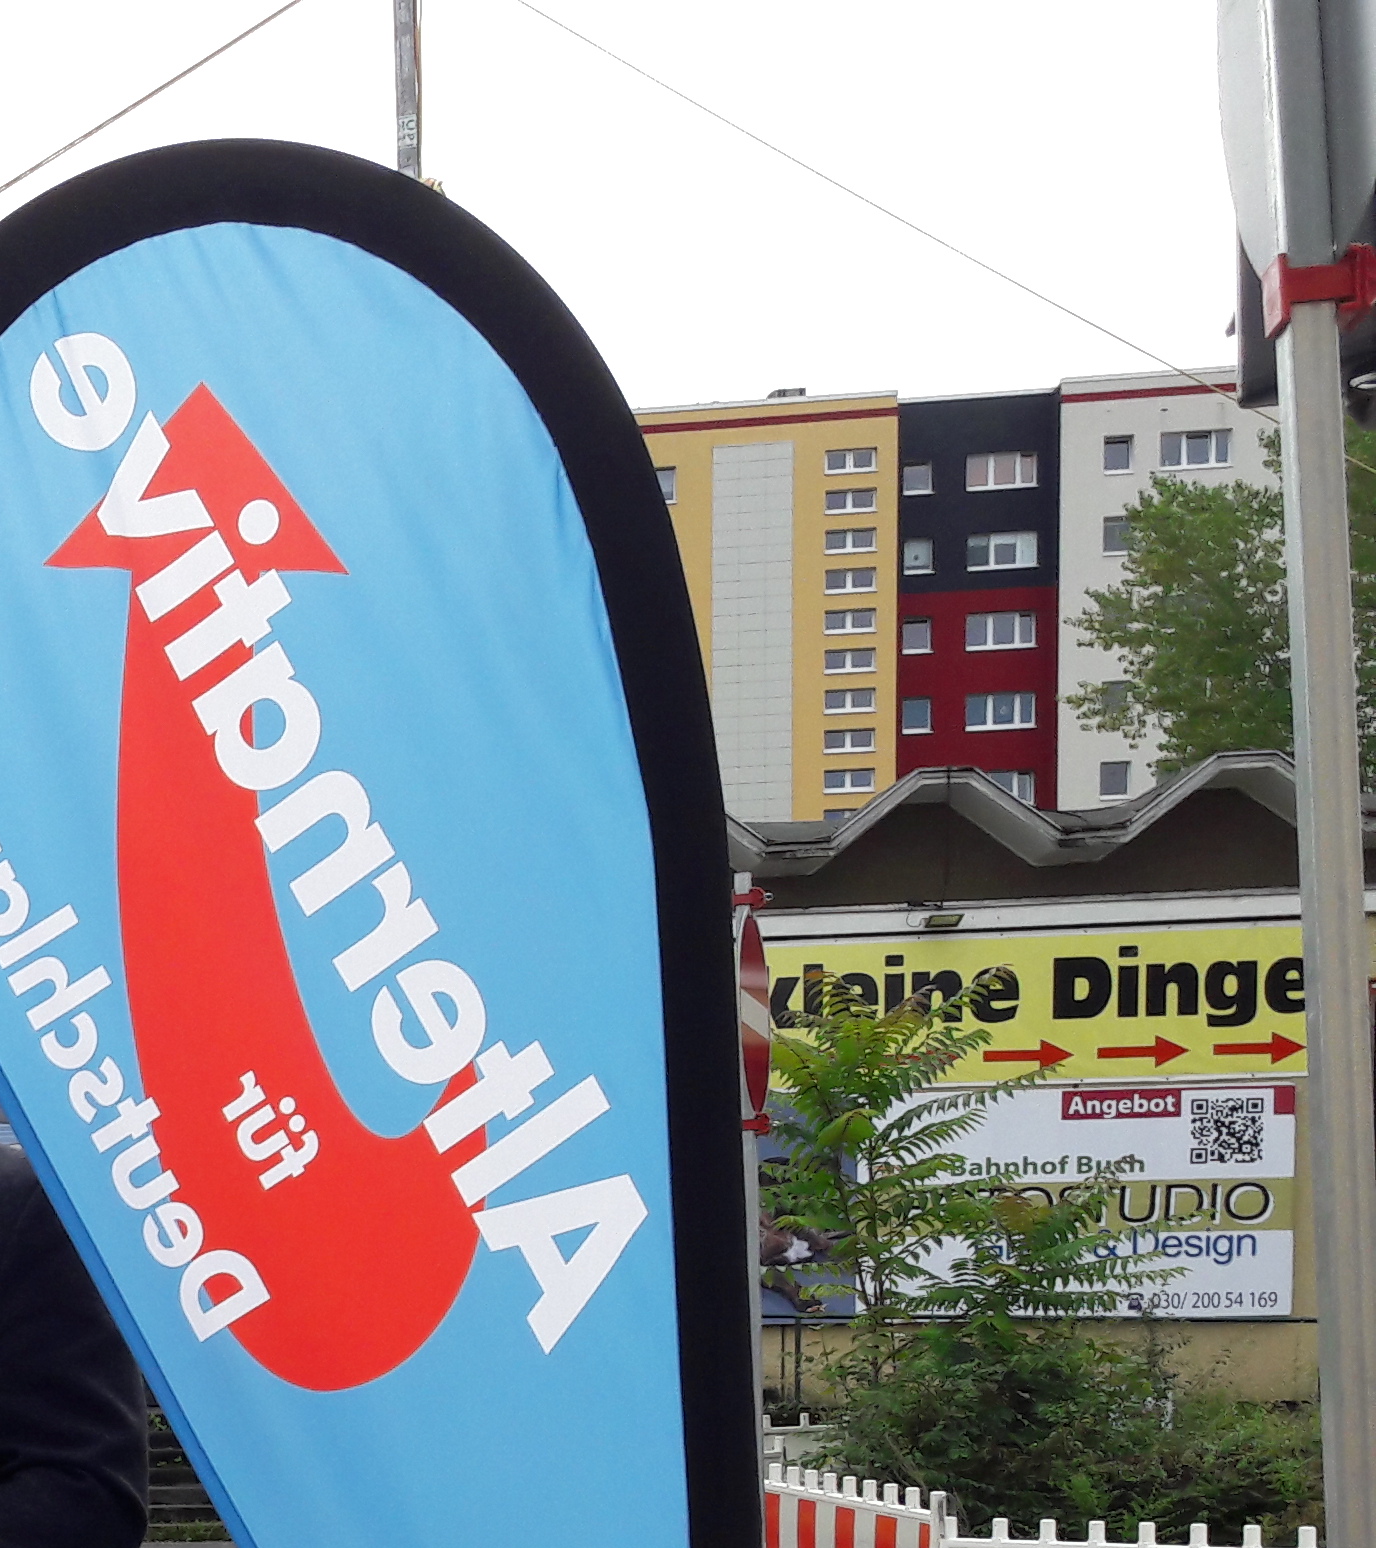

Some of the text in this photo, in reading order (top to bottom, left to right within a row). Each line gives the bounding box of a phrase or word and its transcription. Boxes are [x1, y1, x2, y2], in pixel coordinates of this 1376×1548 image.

[1052, 946, 1306, 1027] Dinge
[1068, 1096, 1176, 1119] Angebot
[950, 1155, 1070, 1177] Bahnhof
[1248, 1291, 1278, 1308] 169
